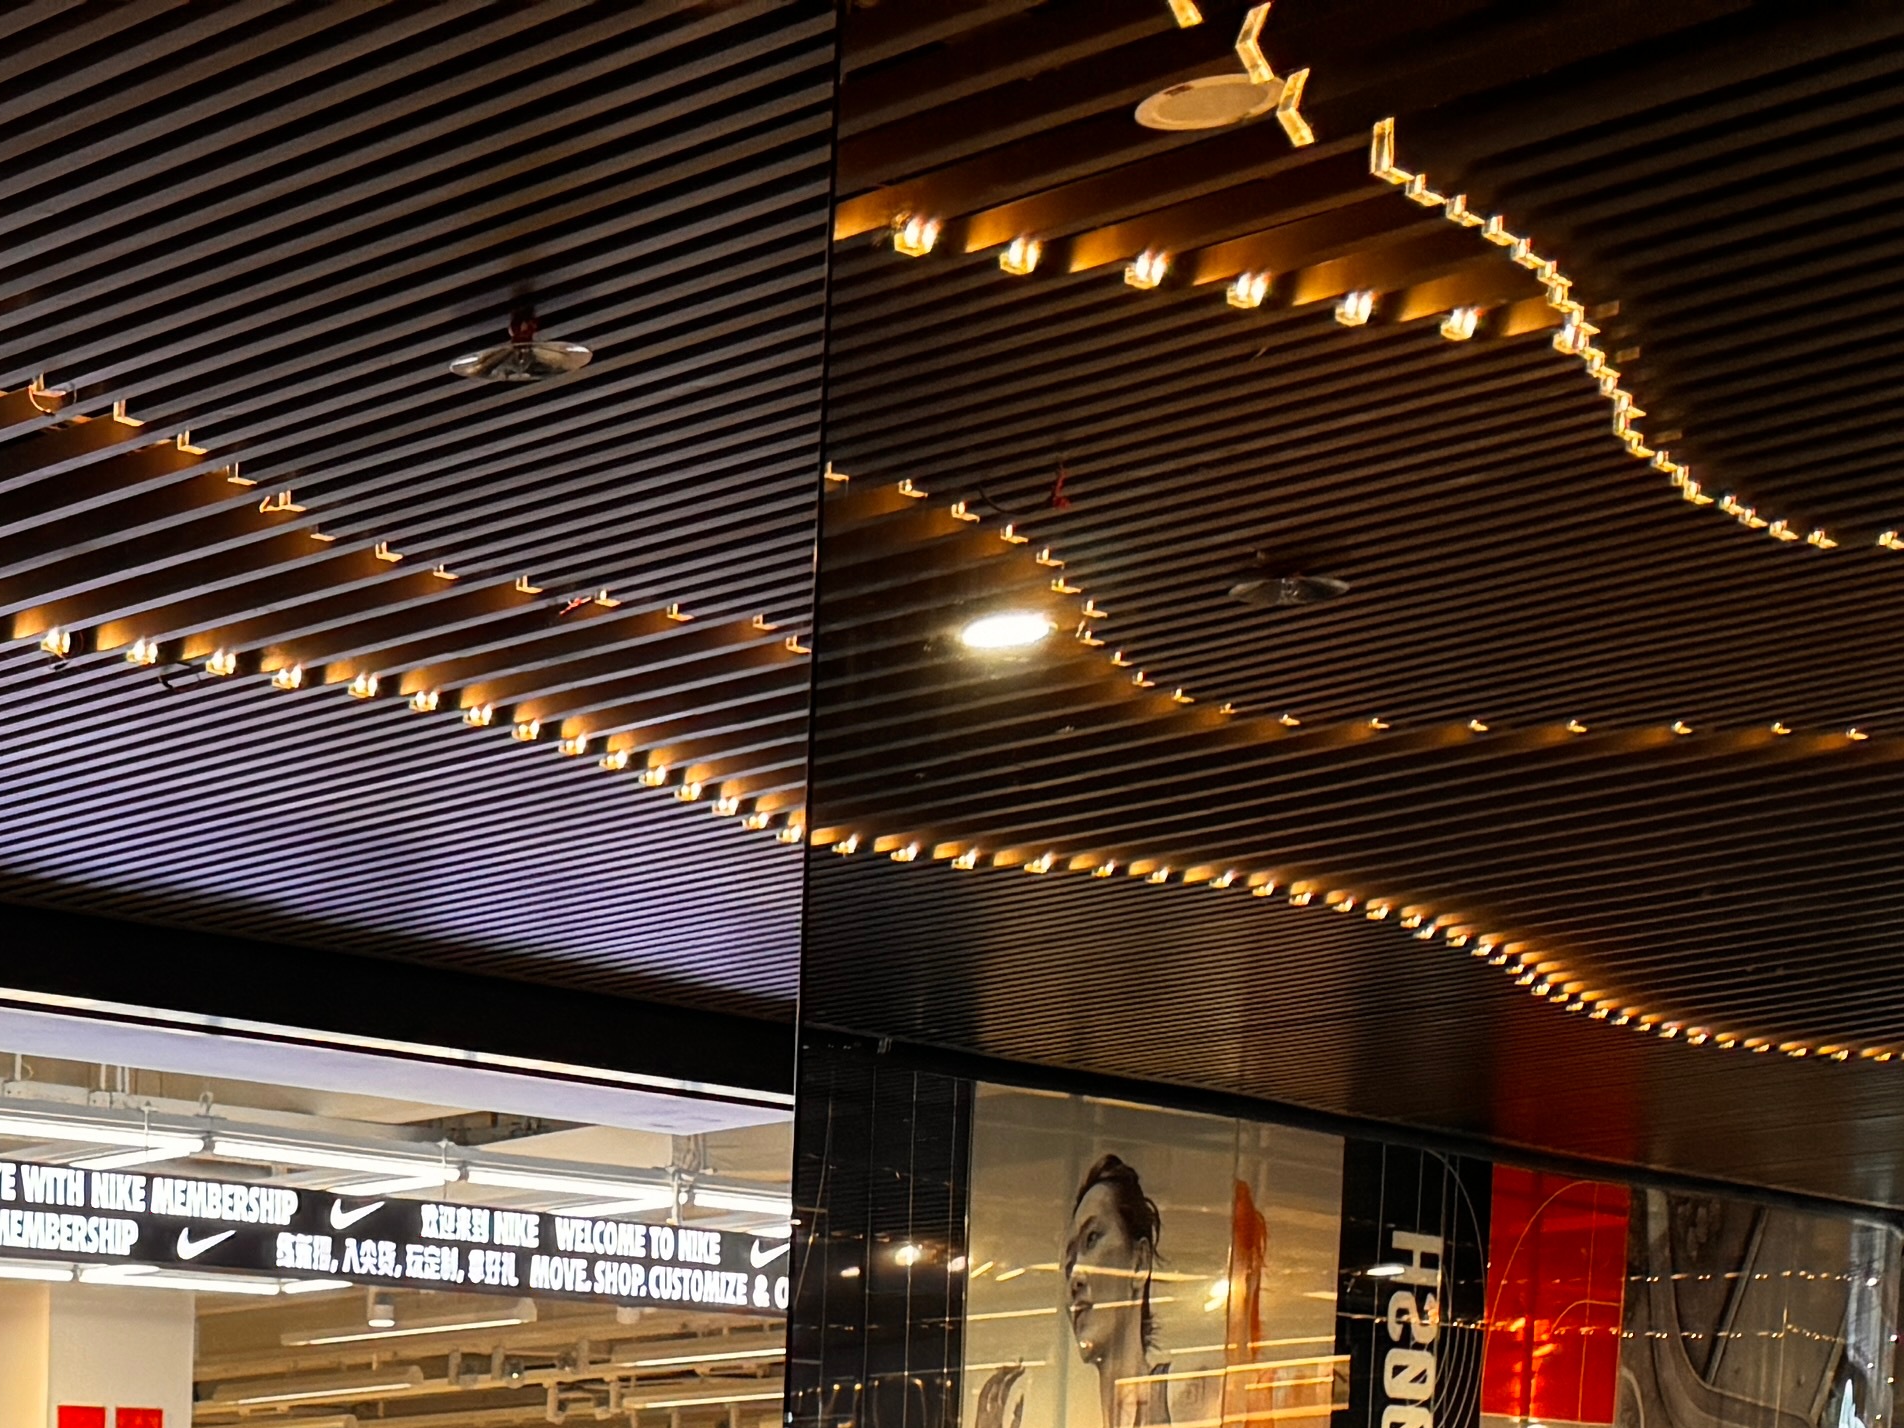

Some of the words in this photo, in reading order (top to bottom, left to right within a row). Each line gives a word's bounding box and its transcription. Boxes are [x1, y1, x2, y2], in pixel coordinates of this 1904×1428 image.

[23, 1164, 85, 1208] WITH
[91, 1171, 146, 1213] NIKE
[150, 1176, 298, 1225] MEMBERSHIP
[422, 1203, 490, 1245] 欢迎来到
[495, 1211, 539, 1247] NIKE
[555, 1216, 644, 1259] WELCOME
[650, 1225, 674, 1260] TO
[678, 1228, 720, 1264] NIKE
[649, 1265, 747, 1306] CUSTOMIZE
[753, 1273, 769, 1307] &
